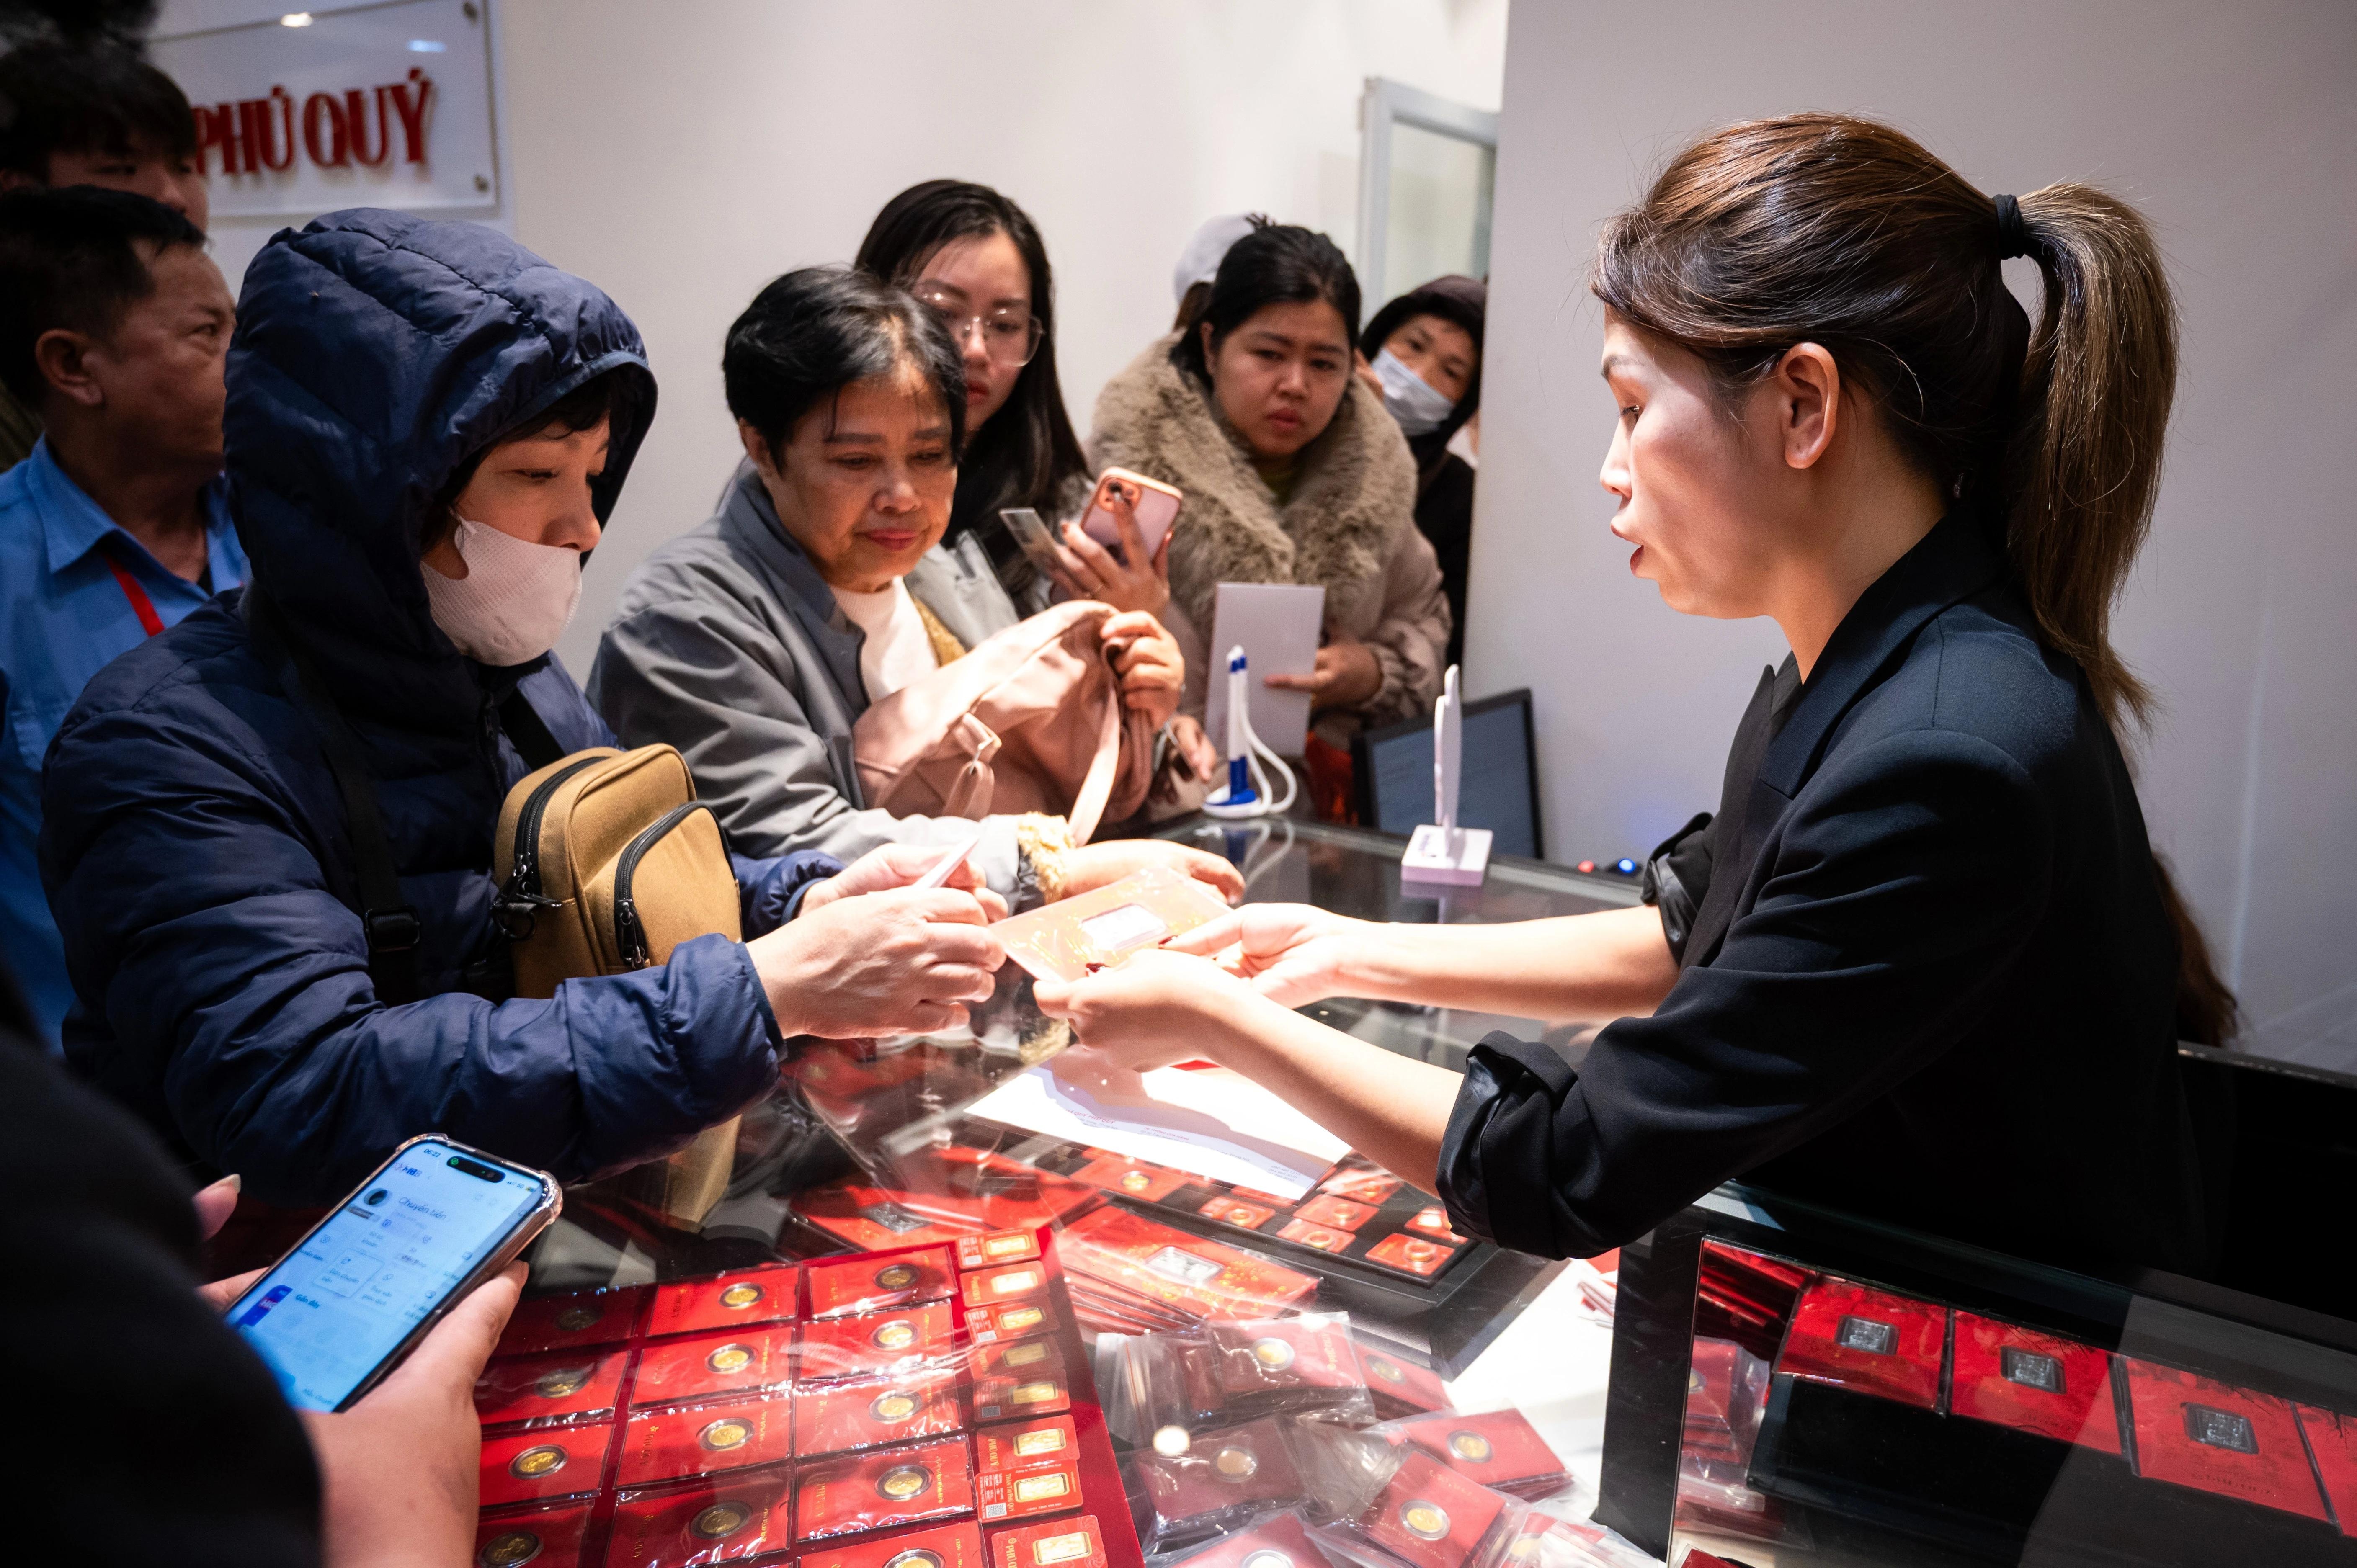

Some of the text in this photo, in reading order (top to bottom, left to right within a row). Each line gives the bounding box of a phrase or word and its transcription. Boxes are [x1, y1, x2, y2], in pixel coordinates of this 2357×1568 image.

[191, 66, 433, 175] PHÚ QUÝ
[424, 1148, 441, 1157] 06:22
[988, 1438, 998, 1451] PHÚ
[990, 1452, 1000, 1466] QUÝ
[1006, 1545, 1017, 1561] PHÚ
